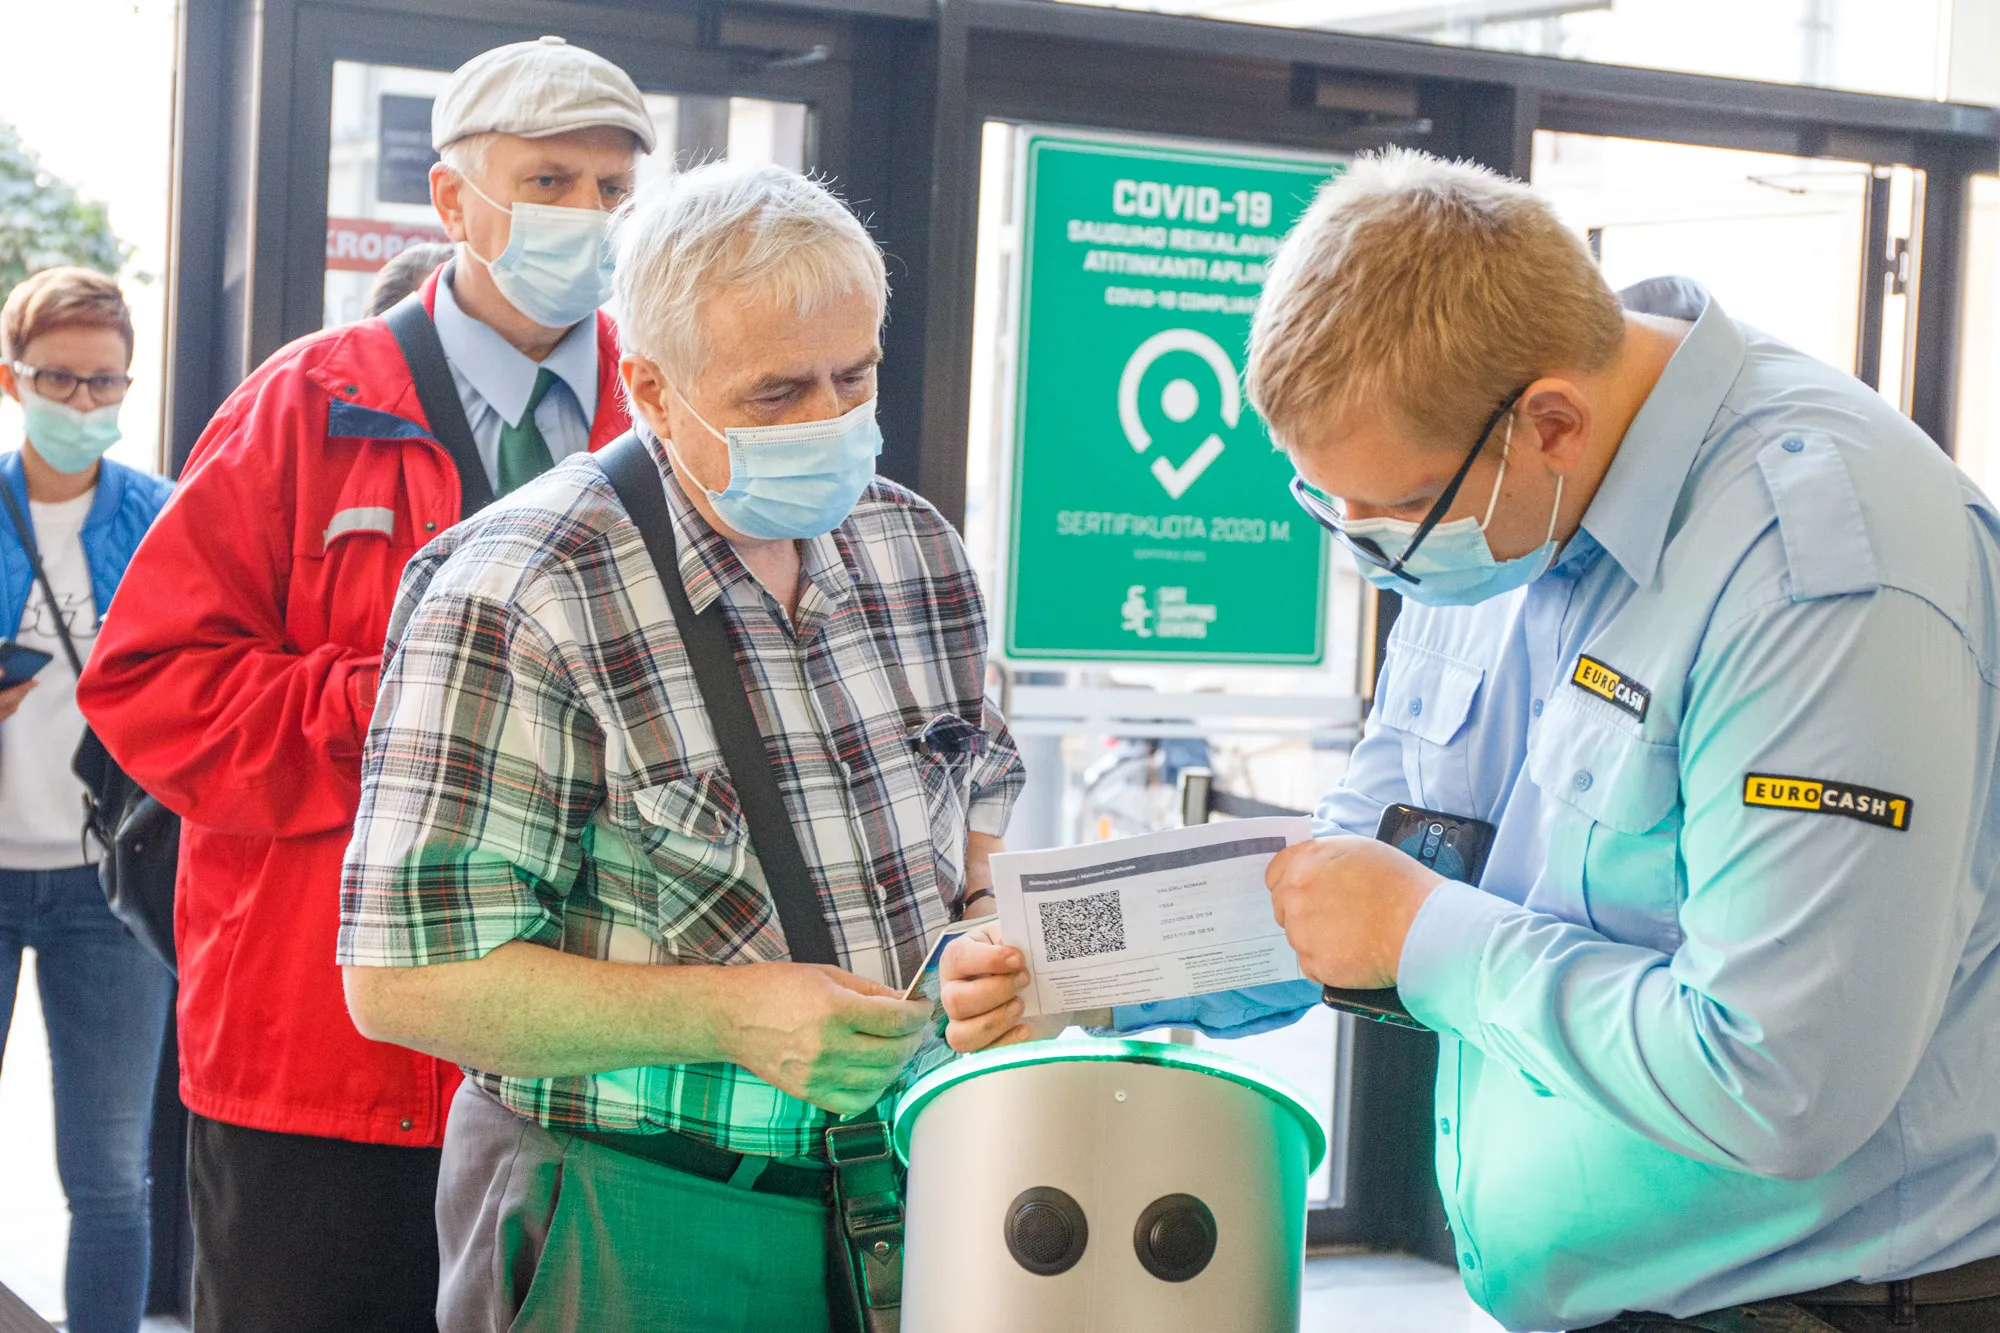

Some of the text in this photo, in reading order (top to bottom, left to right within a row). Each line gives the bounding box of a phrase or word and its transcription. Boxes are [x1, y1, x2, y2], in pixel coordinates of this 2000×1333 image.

[1112, 178, 1272, 228] COVID-19
[1067, 219, 1166, 249] SAUGUMO
[1209, 517, 1266, 543] 2020
[1582, 665, 1645, 711] EUROCASH
